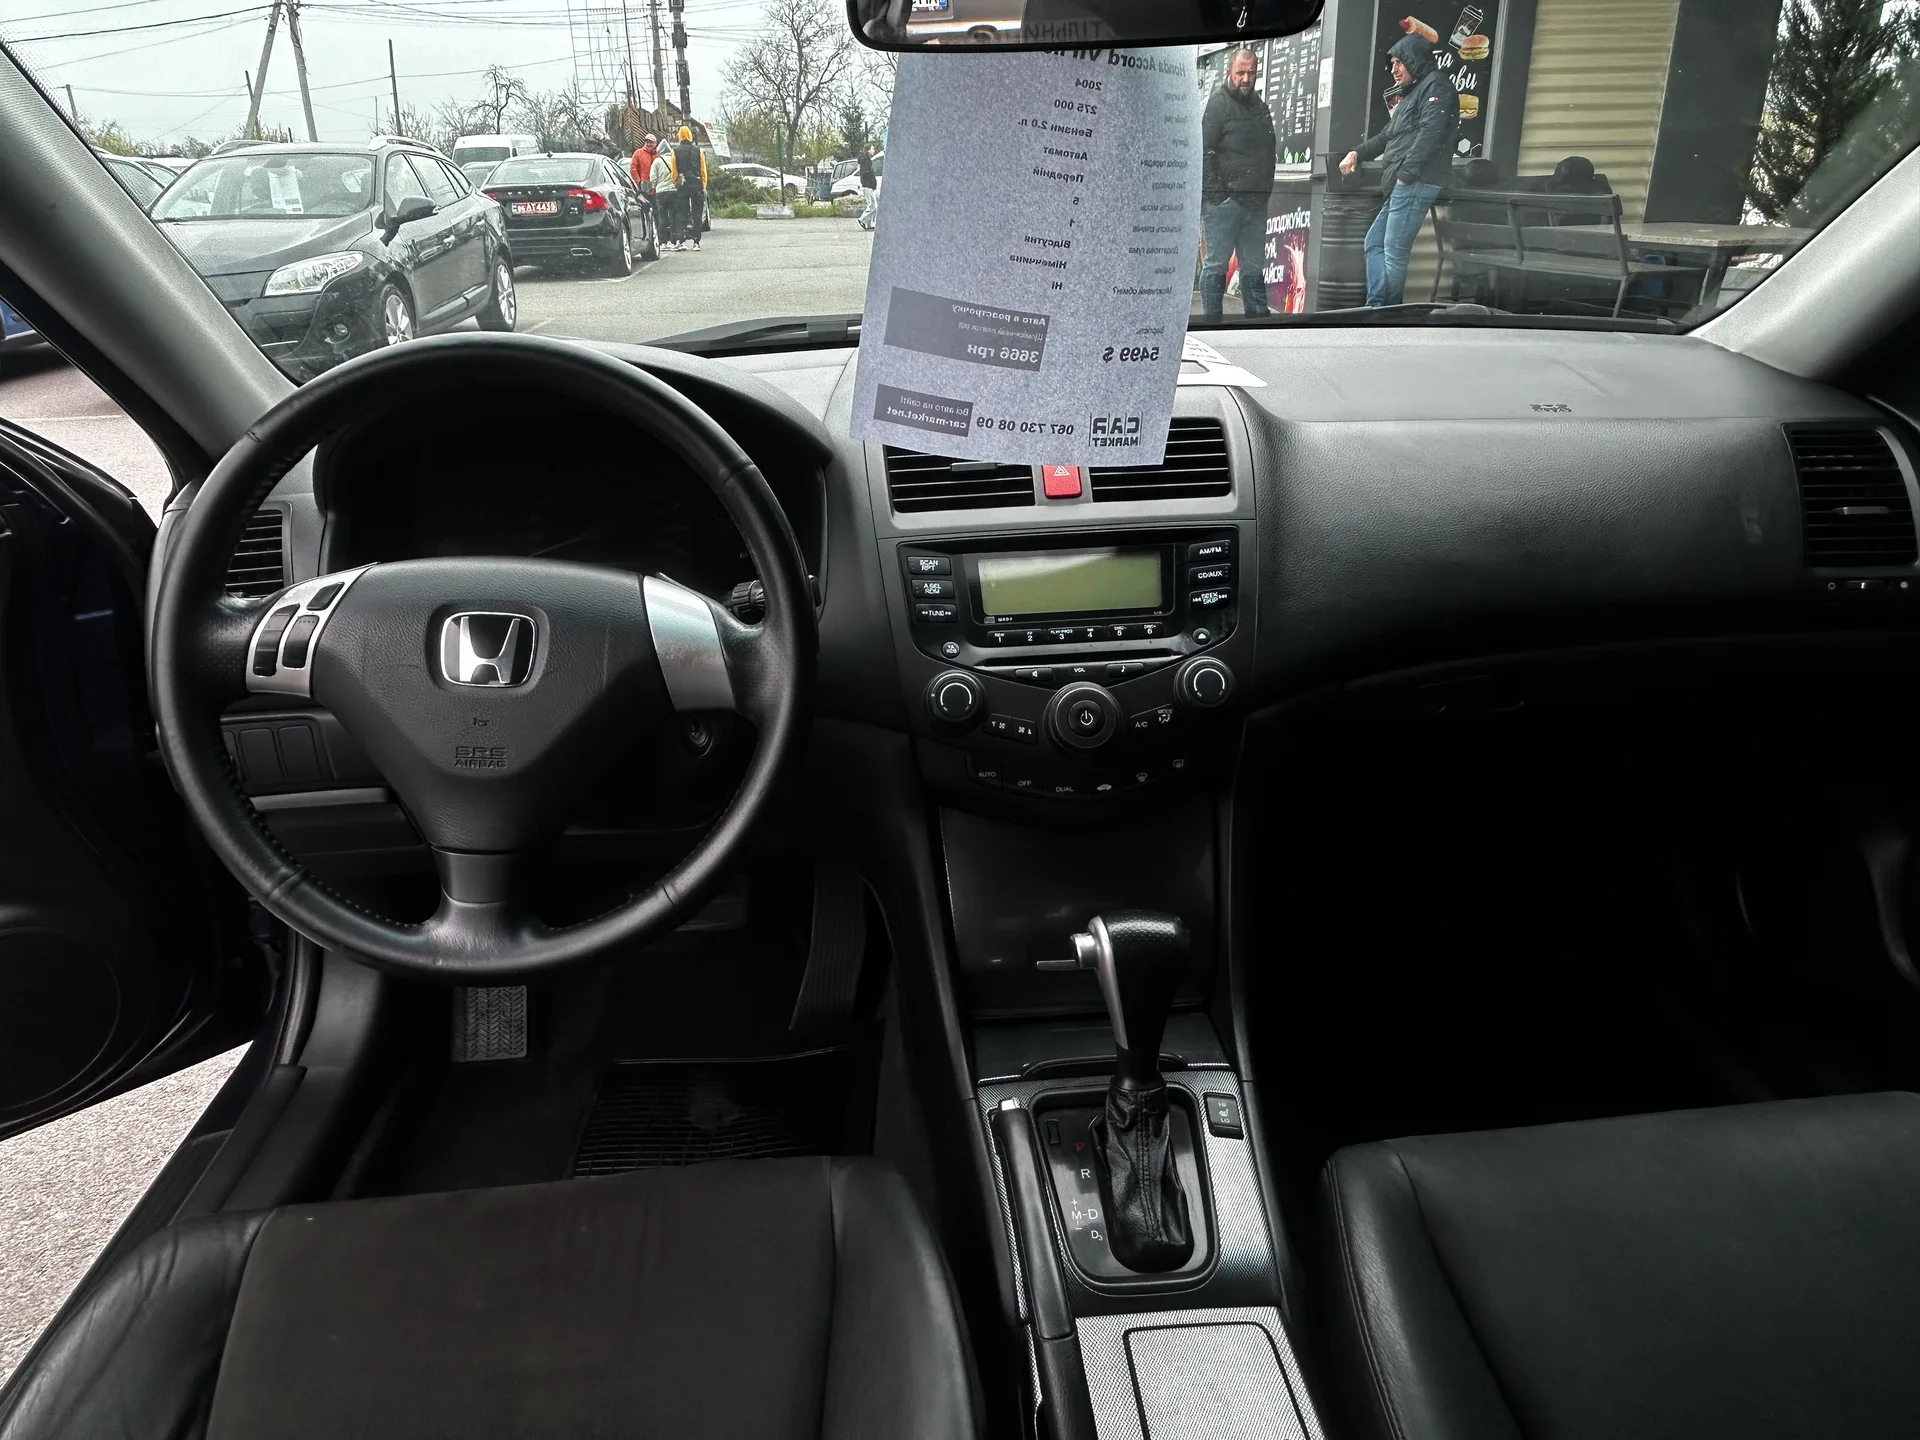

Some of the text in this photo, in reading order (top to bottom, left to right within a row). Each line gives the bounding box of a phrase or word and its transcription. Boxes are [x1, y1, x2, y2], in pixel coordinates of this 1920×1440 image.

[1197, 570, 1223, 579] CD/AUX
[1134, 720, 1148, 729] A/C
[1080, 1169, 1091, 1179] R
